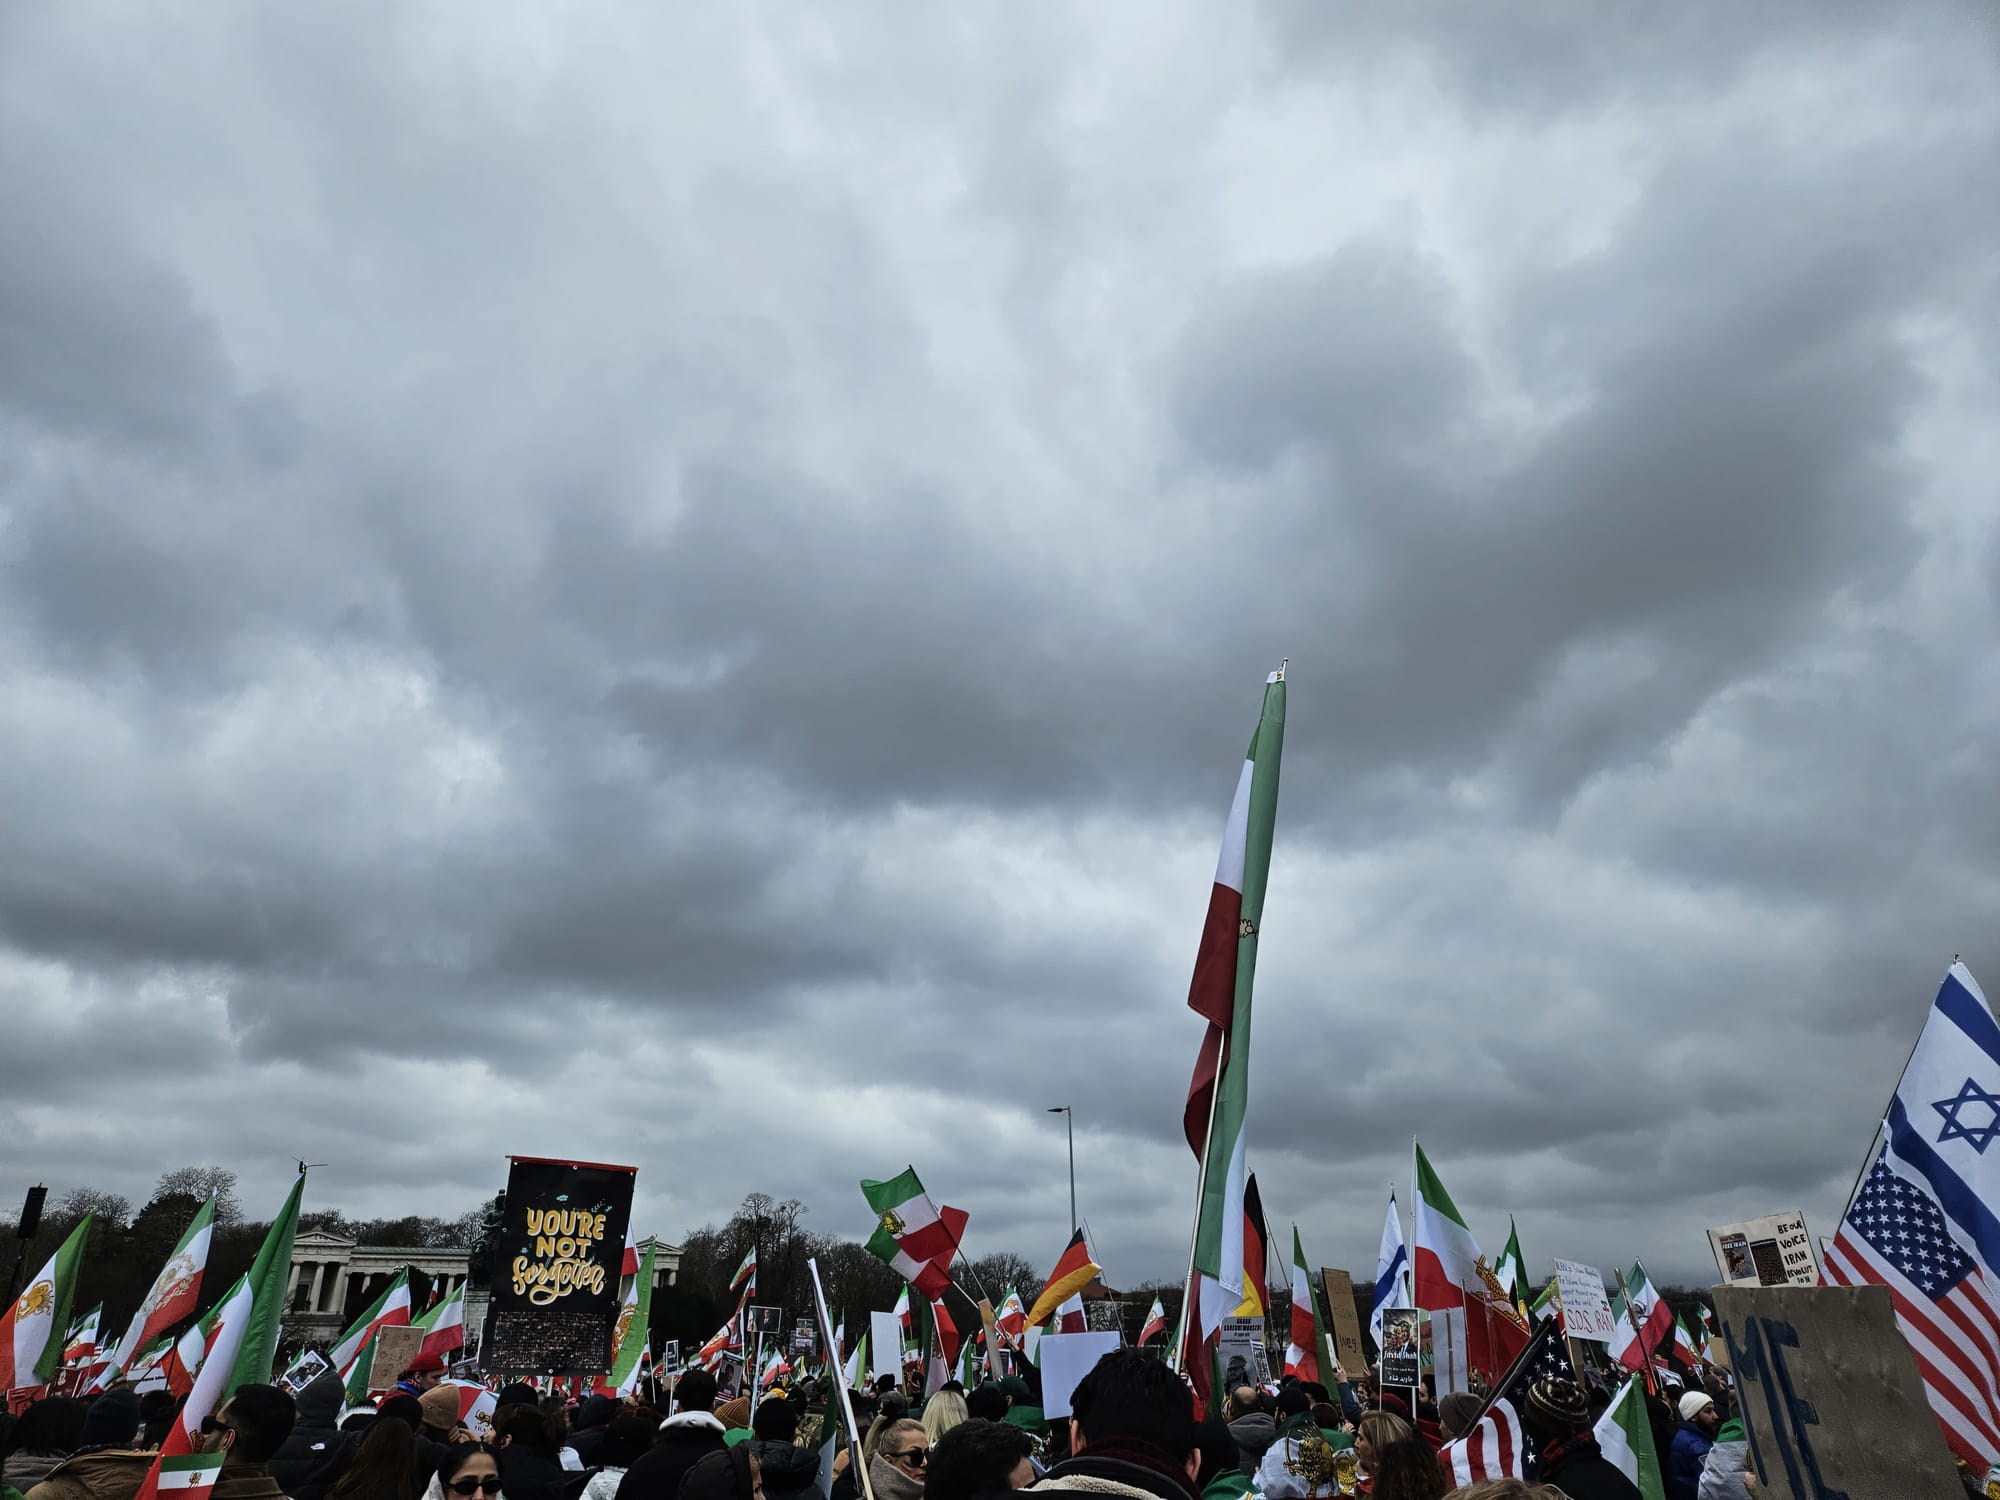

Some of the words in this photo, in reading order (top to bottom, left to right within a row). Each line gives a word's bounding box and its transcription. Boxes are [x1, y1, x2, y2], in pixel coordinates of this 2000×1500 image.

[527, 1208, 606, 1240] YOU'RE
[1777, 1223, 1788, 1234] BE
[1789, 1220, 1803, 1230] OUR
[535, 1236, 592, 1258] NOT
[1780, 1234, 1806, 1249] VOICE
[1784, 1250, 1807, 1265] IRAN
